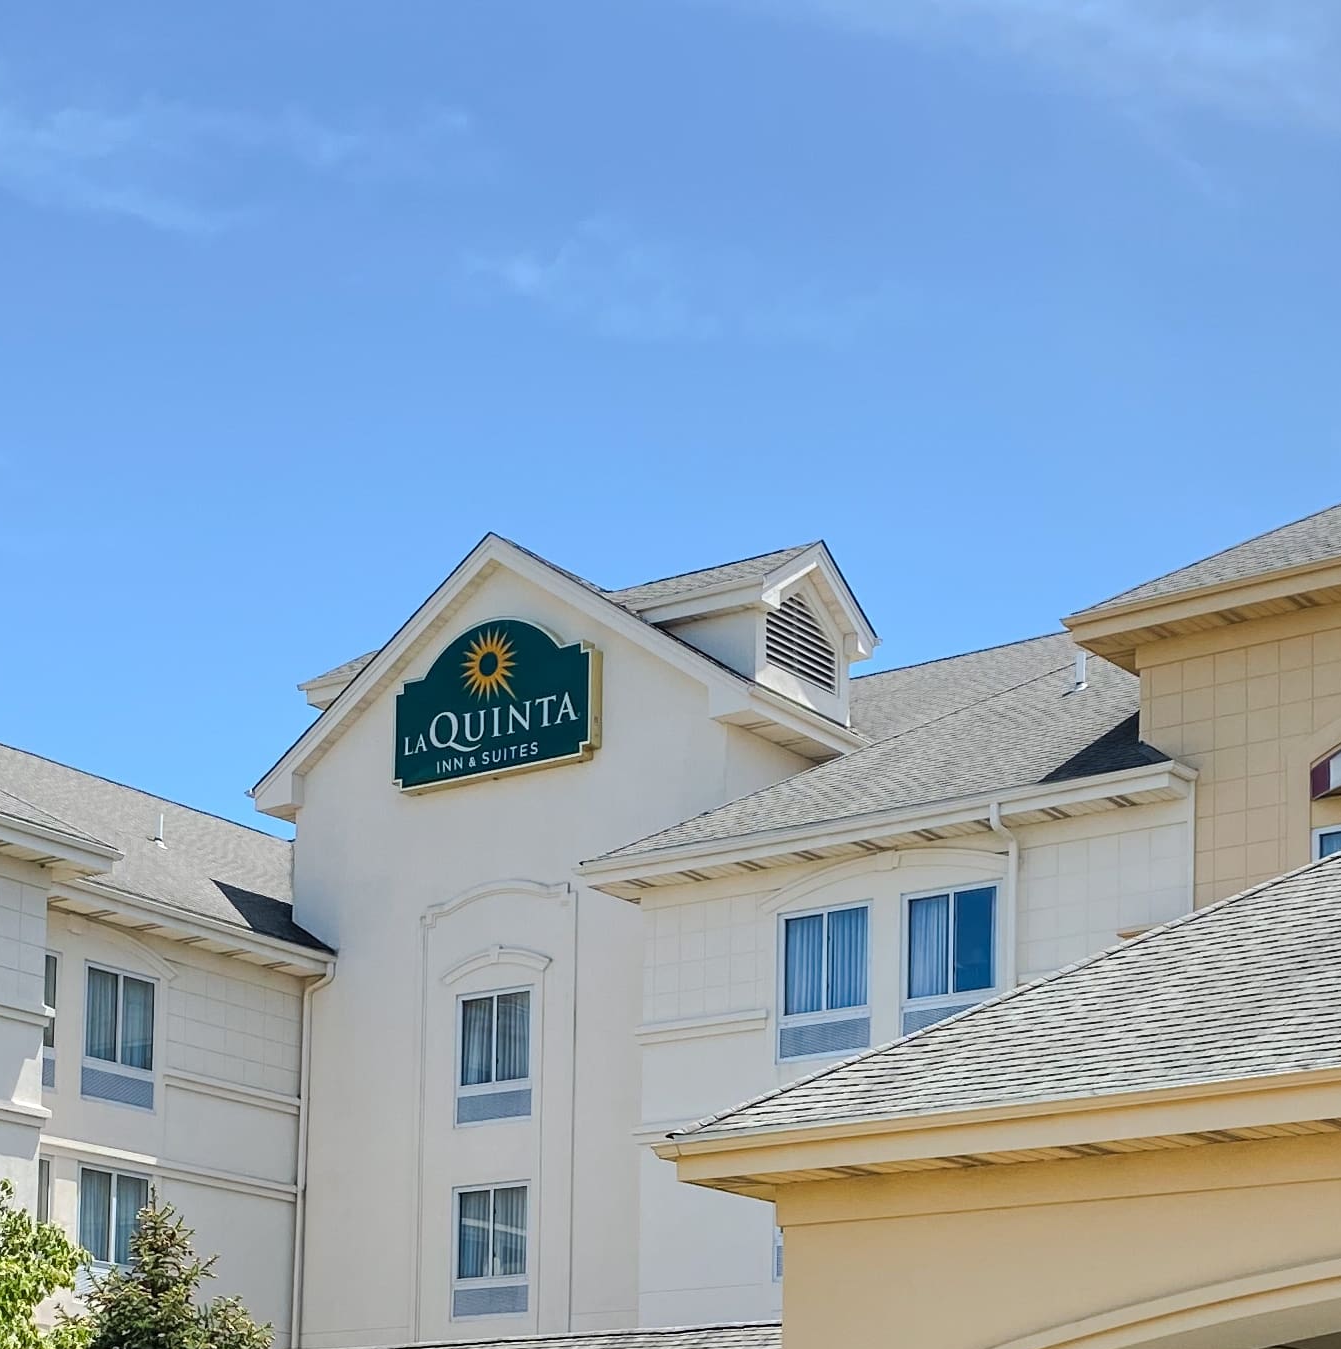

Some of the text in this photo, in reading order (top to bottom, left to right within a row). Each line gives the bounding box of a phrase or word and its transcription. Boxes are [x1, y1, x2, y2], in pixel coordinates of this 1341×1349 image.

[429, 691, 579, 752] QUINTA
[436, 741, 539, 774] INN & SUITES
